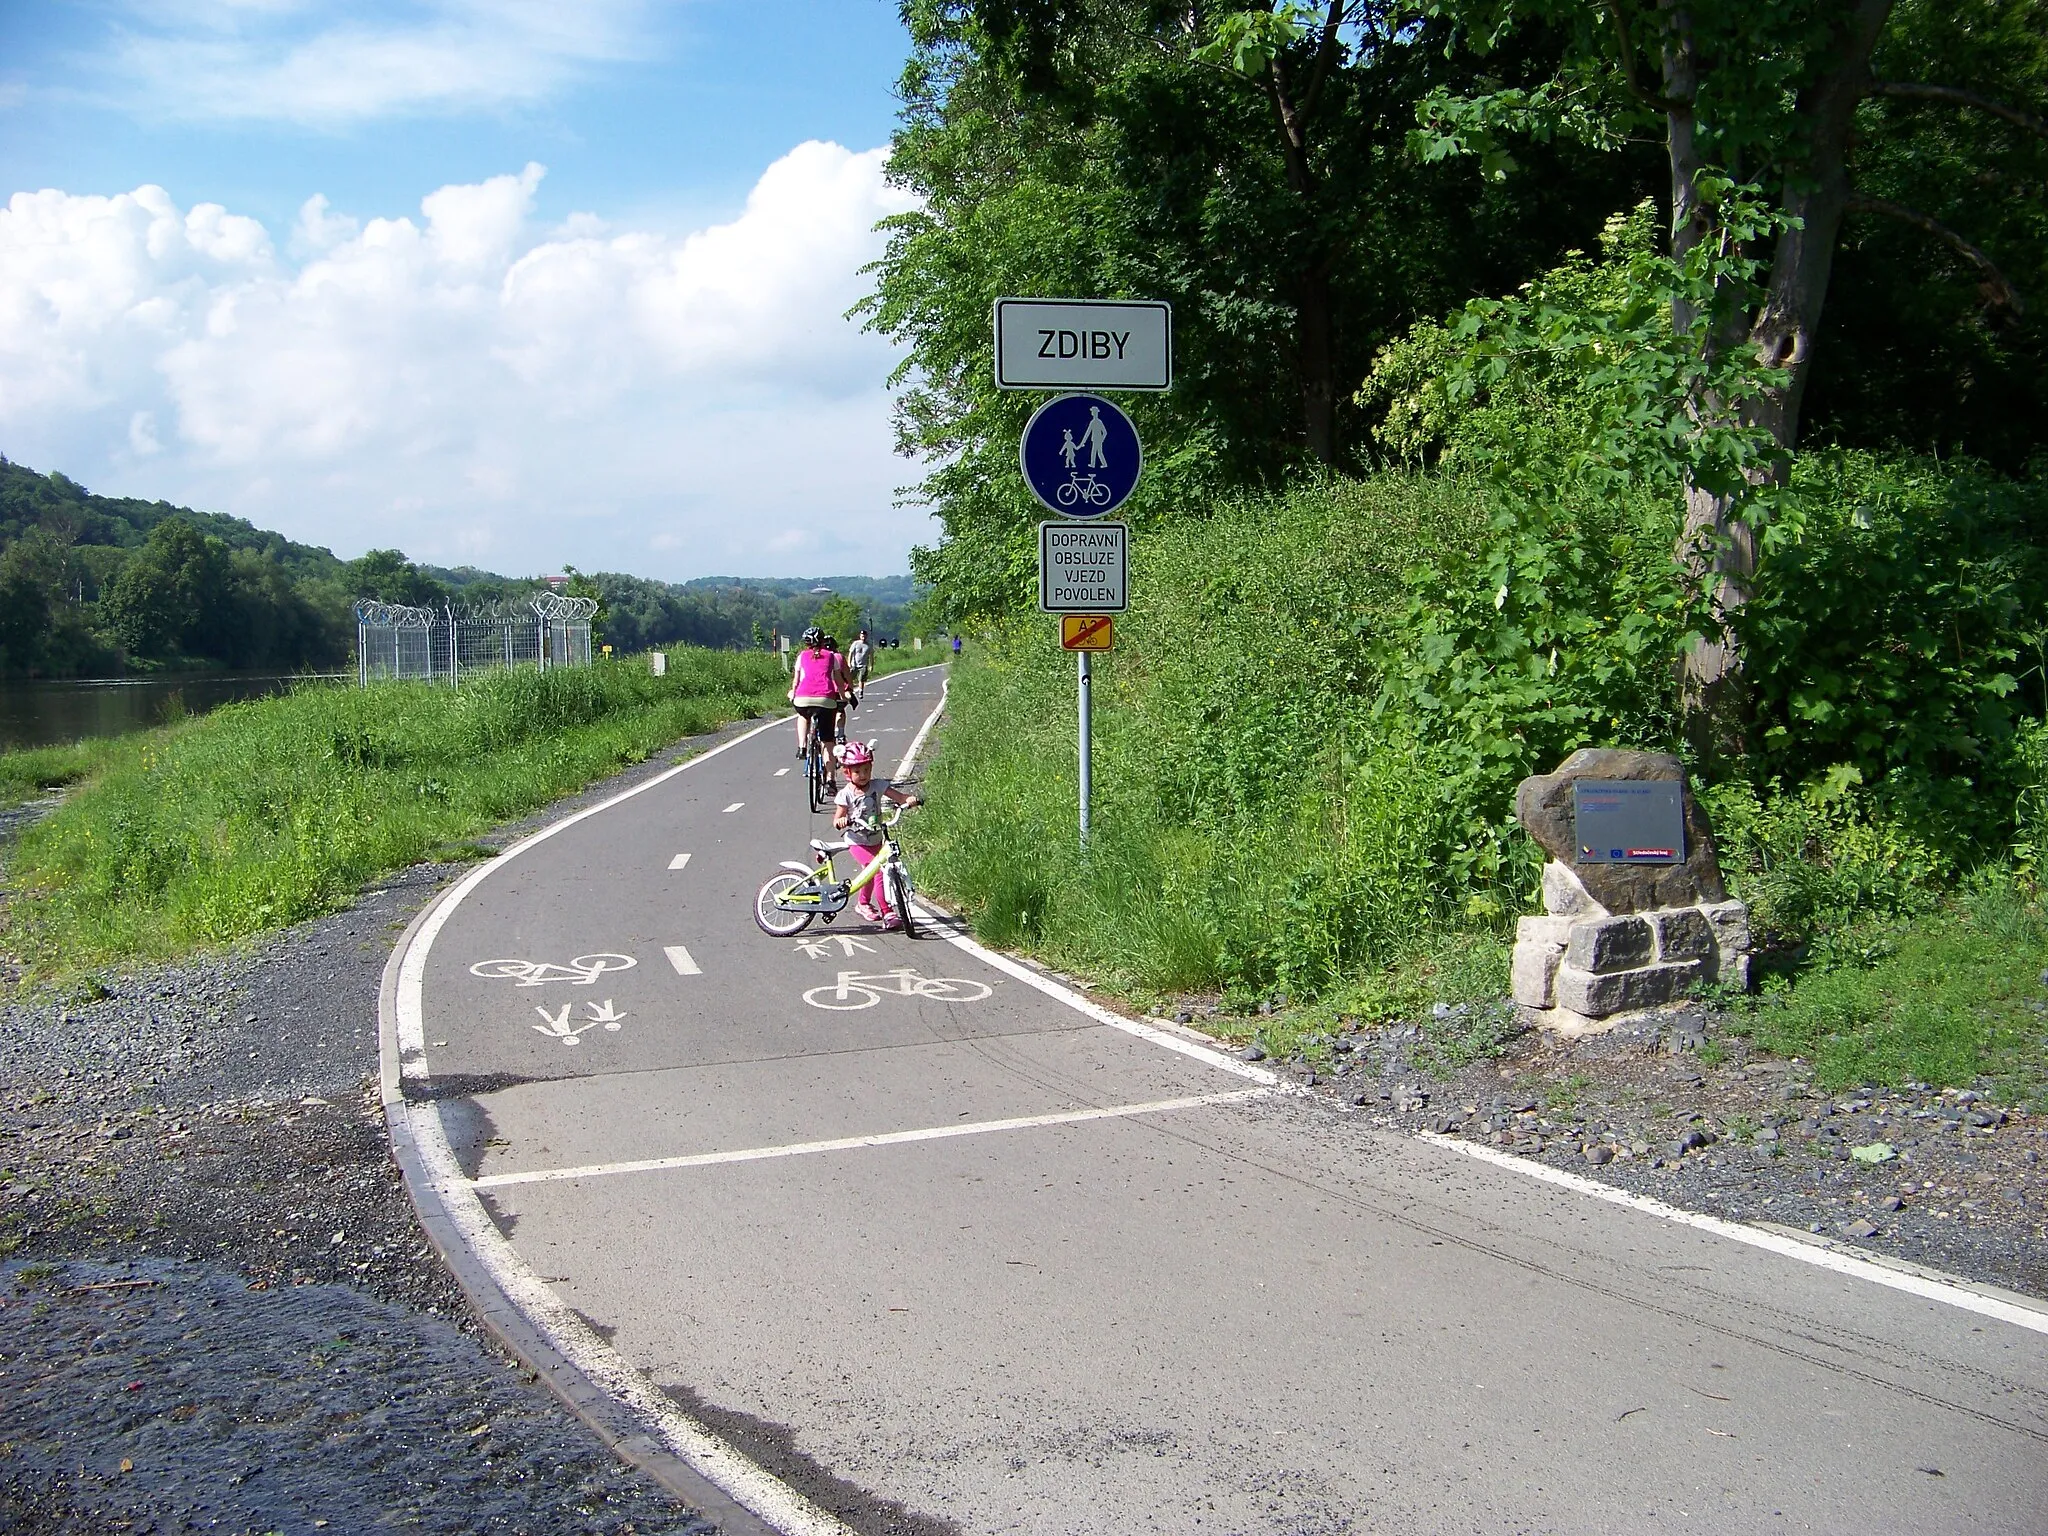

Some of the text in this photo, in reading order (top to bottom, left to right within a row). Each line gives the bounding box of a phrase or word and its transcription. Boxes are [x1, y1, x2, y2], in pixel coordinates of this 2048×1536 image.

[1037, 329, 1131, 360] ZDIBY
[1051, 531, 1119, 547] DOPRAVNÍ
[1054, 551, 1115, 565] OBSLUZE
[1064, 569, 1106, 583] VJEZD
[1054, 587, 1116, 601] POVOLEN
